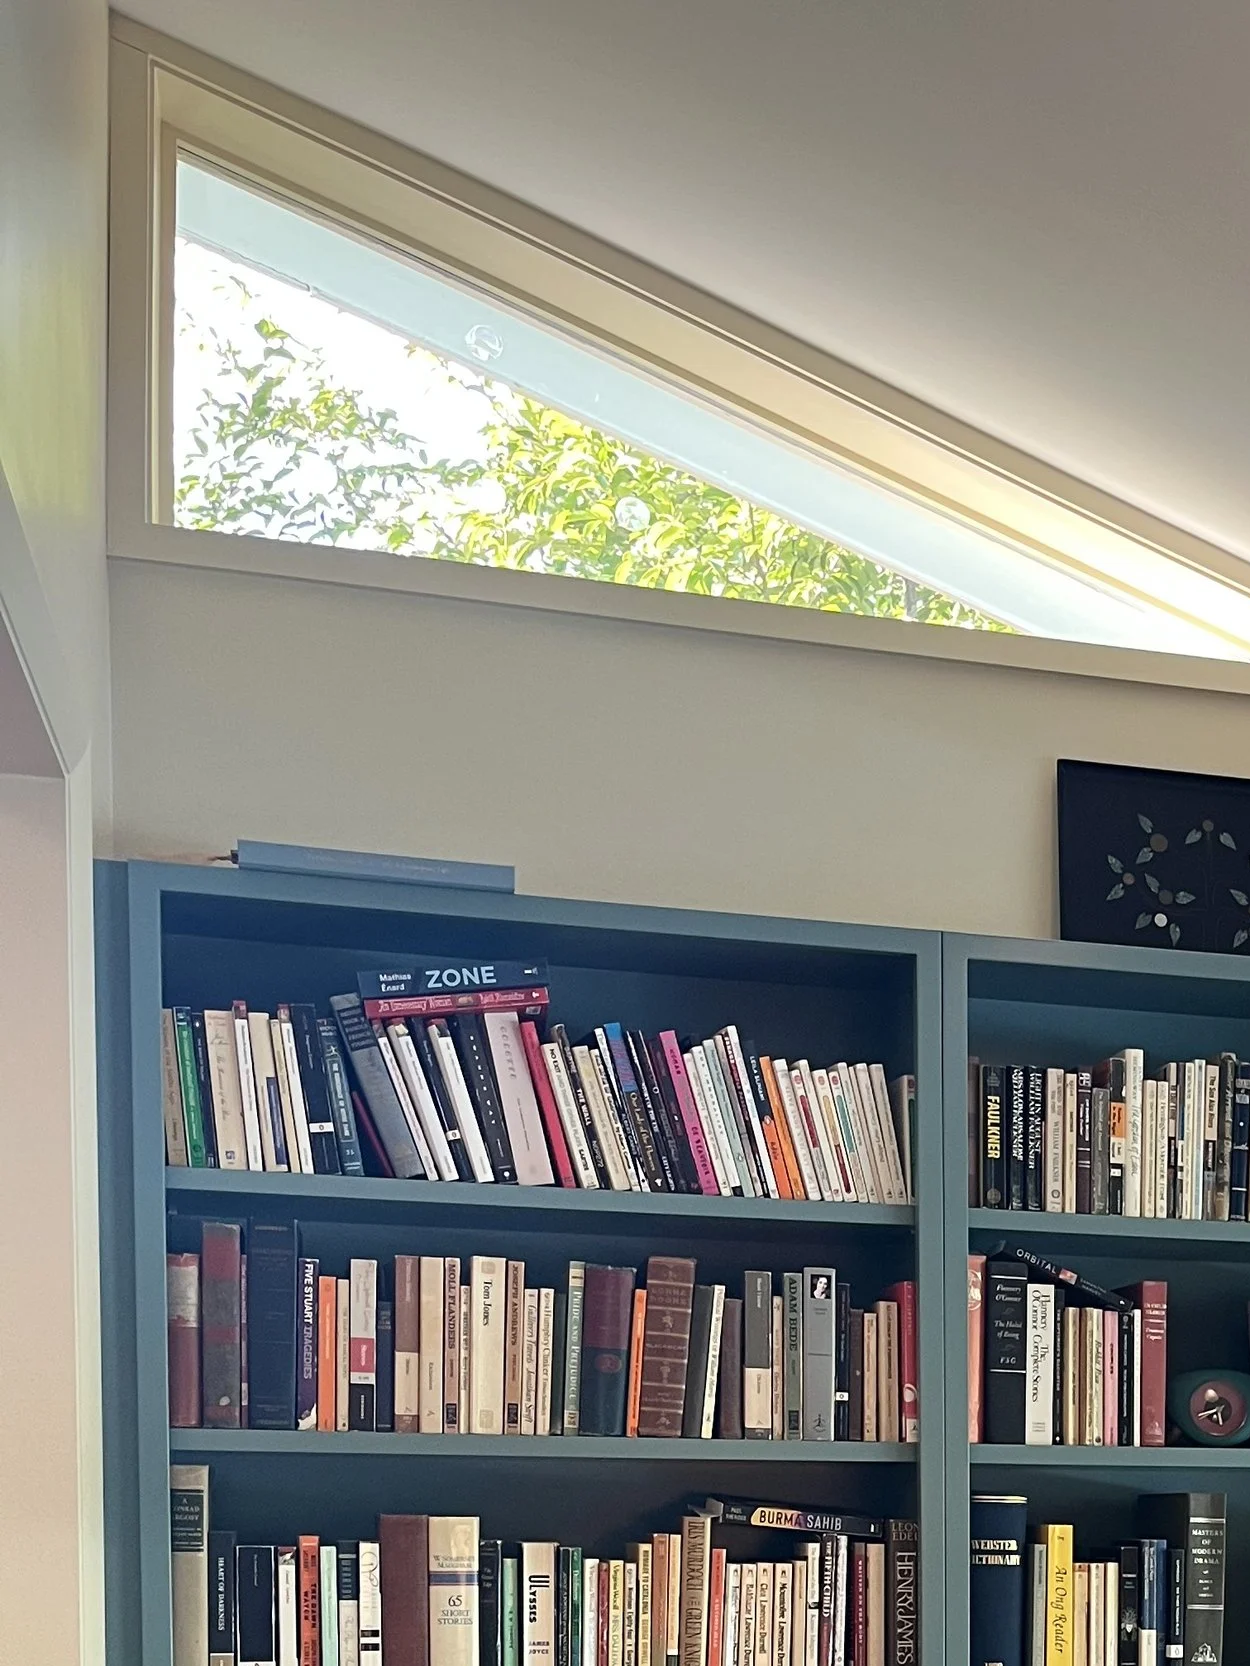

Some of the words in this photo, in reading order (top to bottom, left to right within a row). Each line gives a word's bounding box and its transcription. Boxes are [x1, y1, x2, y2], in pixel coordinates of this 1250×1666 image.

[424, 964, 497, 989] ZONE
[548, 1047, 557, 1059] NO
[551, 1059, 562, 1074] EXIT
[1208, 1075, 1217, 1086] The
[1208, 1086, 1216, 1098] Sun
[575, 1087, 586, 1104] THE
[1034, 1103, 1041, 1114] IN
[580, 1103, 592, 1127] WALL
[986, 1095, 1000, 1159] FAULKNER
[1052, 1121, 1060, 1149] WILLIAM
[1052, 1152, 1060, 1182] FAULKNER
[303, 1263, 314, 1285] FIVE
[1016, 1248, 1058, 1275] ORBITAL
[447, 1263, 455, 1292] MOLL
[482, 1279, 492, 1299] Tom
[510, 1263, 519, 1299] JOSEPH
[303, 1285, 314, 1324] STUART
[570, 1290, 583, 1321] PRIDE
[788, 1277, 797, 1313] ADAM
[447, 1293, 455, 1350] FLANDERS
[482, 1300, 492, 1327] Jones
[510, 1300, 518, 1346] ANDREWS
[1030, 1289, 1040, 1330] O'Connor
[1039, 1293, 1050, 1331] Flannery
[541, 1308, 551, 1346] Humphry
[570, 1324, 579, 1342] AND
[788, 1317, 797, 1351] BEDE
[302, 1325, 313, 1379] TRAGEDIES
[542, 1347, 550, 1376] Clinker
[1030, 1334, 1042, 1375] Complete
[1039, 1345, 1049, 1360] The
[566, 1344, 580, 1400] PREJUDICE
[1031, 1374, 1041, 1404] Stories
[686, 1520, 705, 1540] IRIS
[758, 1508, 808, 1528] BURMA
[805, 1514, 843, 1531] SAHIB
[1192, 1529, 1224, 1537] MASTERS
[824, 1541, 832, 1555] THE
[1191, 1548, 1224, 1556] MODERN
[1194, 1557, 1220, 1565] DRAMA
[611, 1564, 620, 1590] Virginia
[641, 1575, 649, 1583] TO
[685, 1540, 704, 1592] MURDOCH
[823, 1556, 832, 1584] FIFTH
[1054, 1565, 1067, 1583] An
[217, 1581, 224, 1592] OF
[759, 1582, 768, 1597] Clea
[895, 1551, 916, 1611] HENRY
[448, 1595, 463, 1607] 65
[527, 1574, 550, 1623] ULYSSES
[744, 1583, 754, 1615] Balthazar
[777, 1582, 787, 1619] Mountolive
[821, 1584, 831, 1618] CHILD
[1049, 1586, 1067, 1611] Ong
[437, 1617, 474, 1625] STORIES
[441, 1609, 471, 1617] SHORT
[684, 1607, 701, 1639] GREEN
[758, 1599, 768, 1631] Lawrence
[743, 1617, 753, 1649] Lawrence
[758, 1630, 767, 1655] Durrell
[777, 1620, 787, 1652] Lawrence
[895, 1607, 916, 1665] JAMES
[1051, 1613, 1068, 1654] Reader
